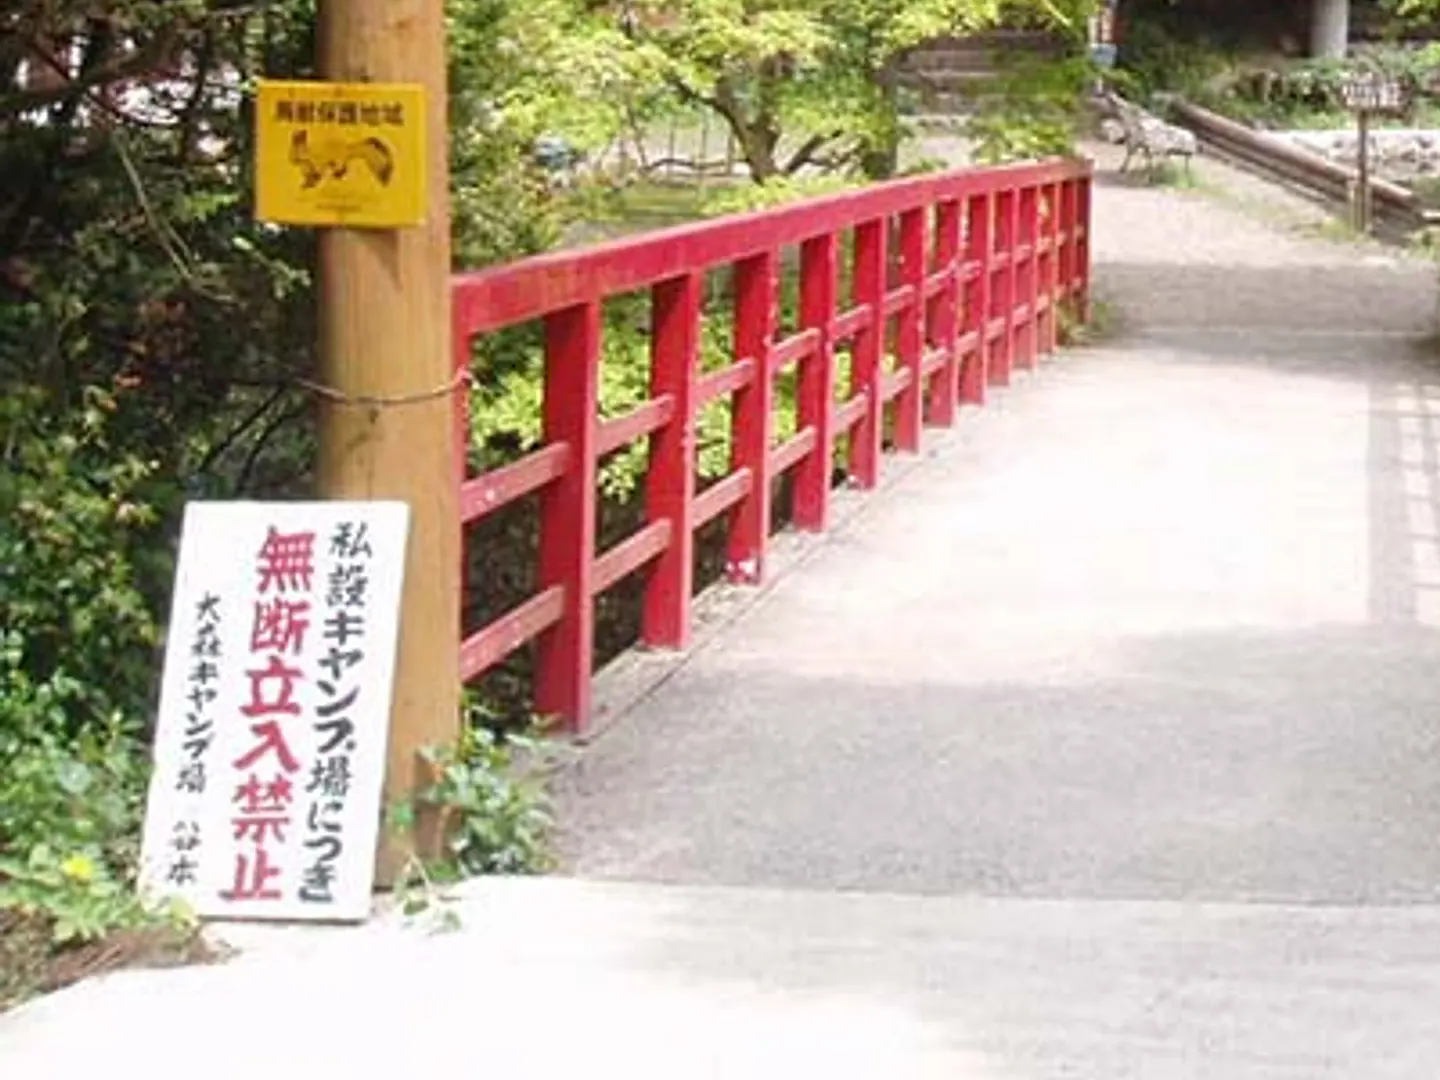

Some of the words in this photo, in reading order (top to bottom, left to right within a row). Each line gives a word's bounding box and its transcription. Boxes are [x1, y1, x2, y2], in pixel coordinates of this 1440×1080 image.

[219, 524, 317, 902] 無断立入禁止
